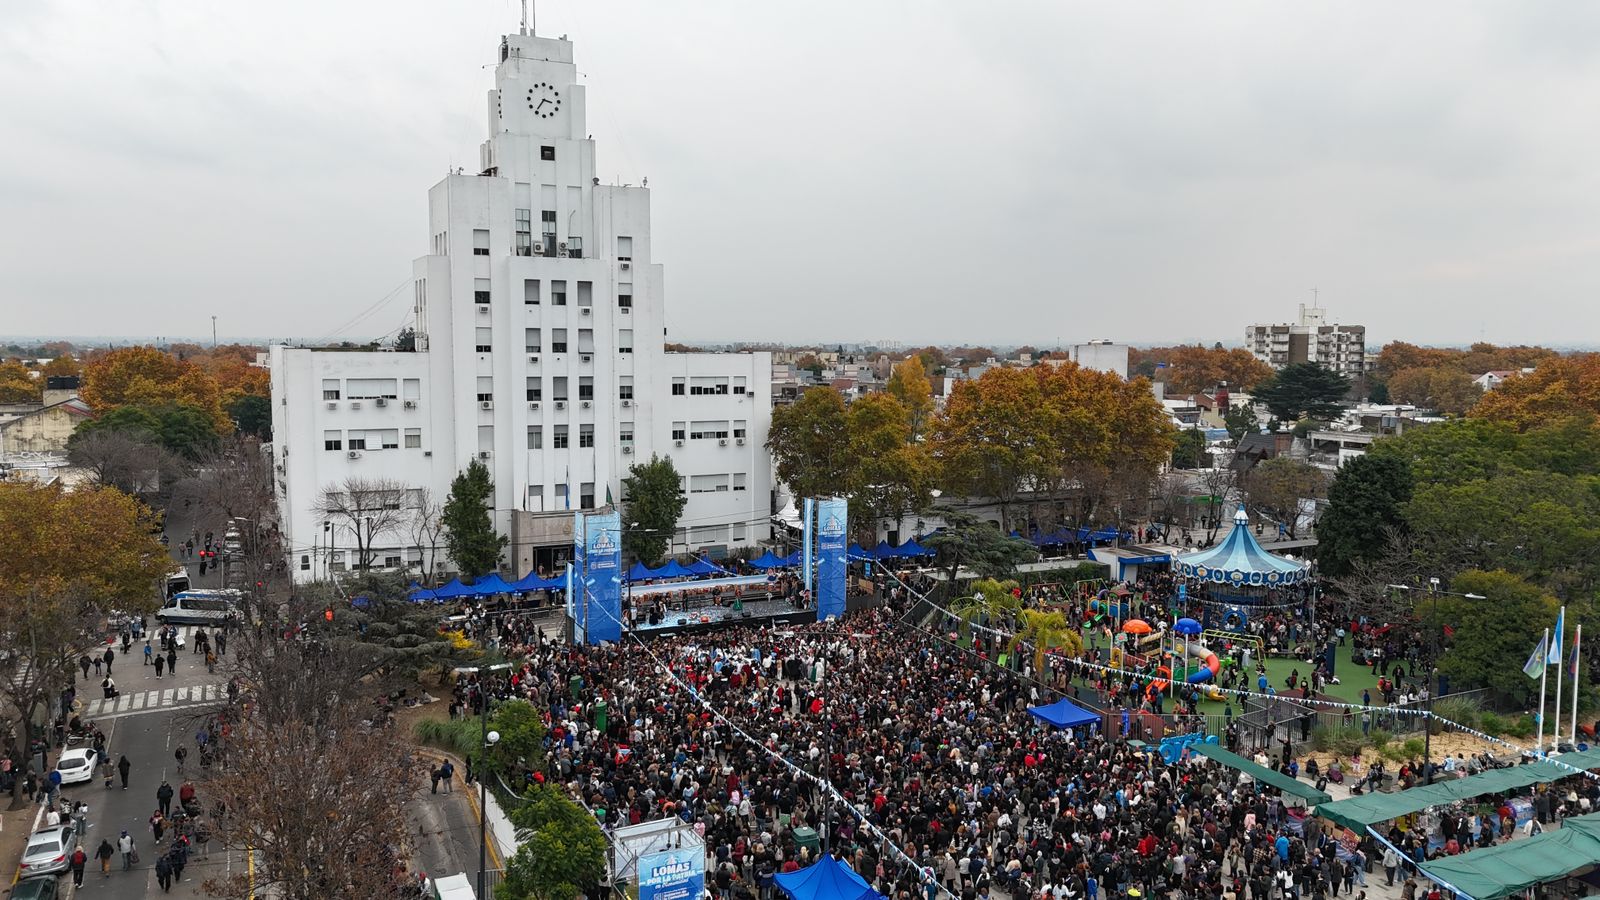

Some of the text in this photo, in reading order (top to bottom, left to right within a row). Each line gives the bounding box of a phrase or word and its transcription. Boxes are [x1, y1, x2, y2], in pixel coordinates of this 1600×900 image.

[653, 863, 690, 877] LOMAS
[647, 877, 661, 885] POR
[671, 870, 698, 880] PATRIA
